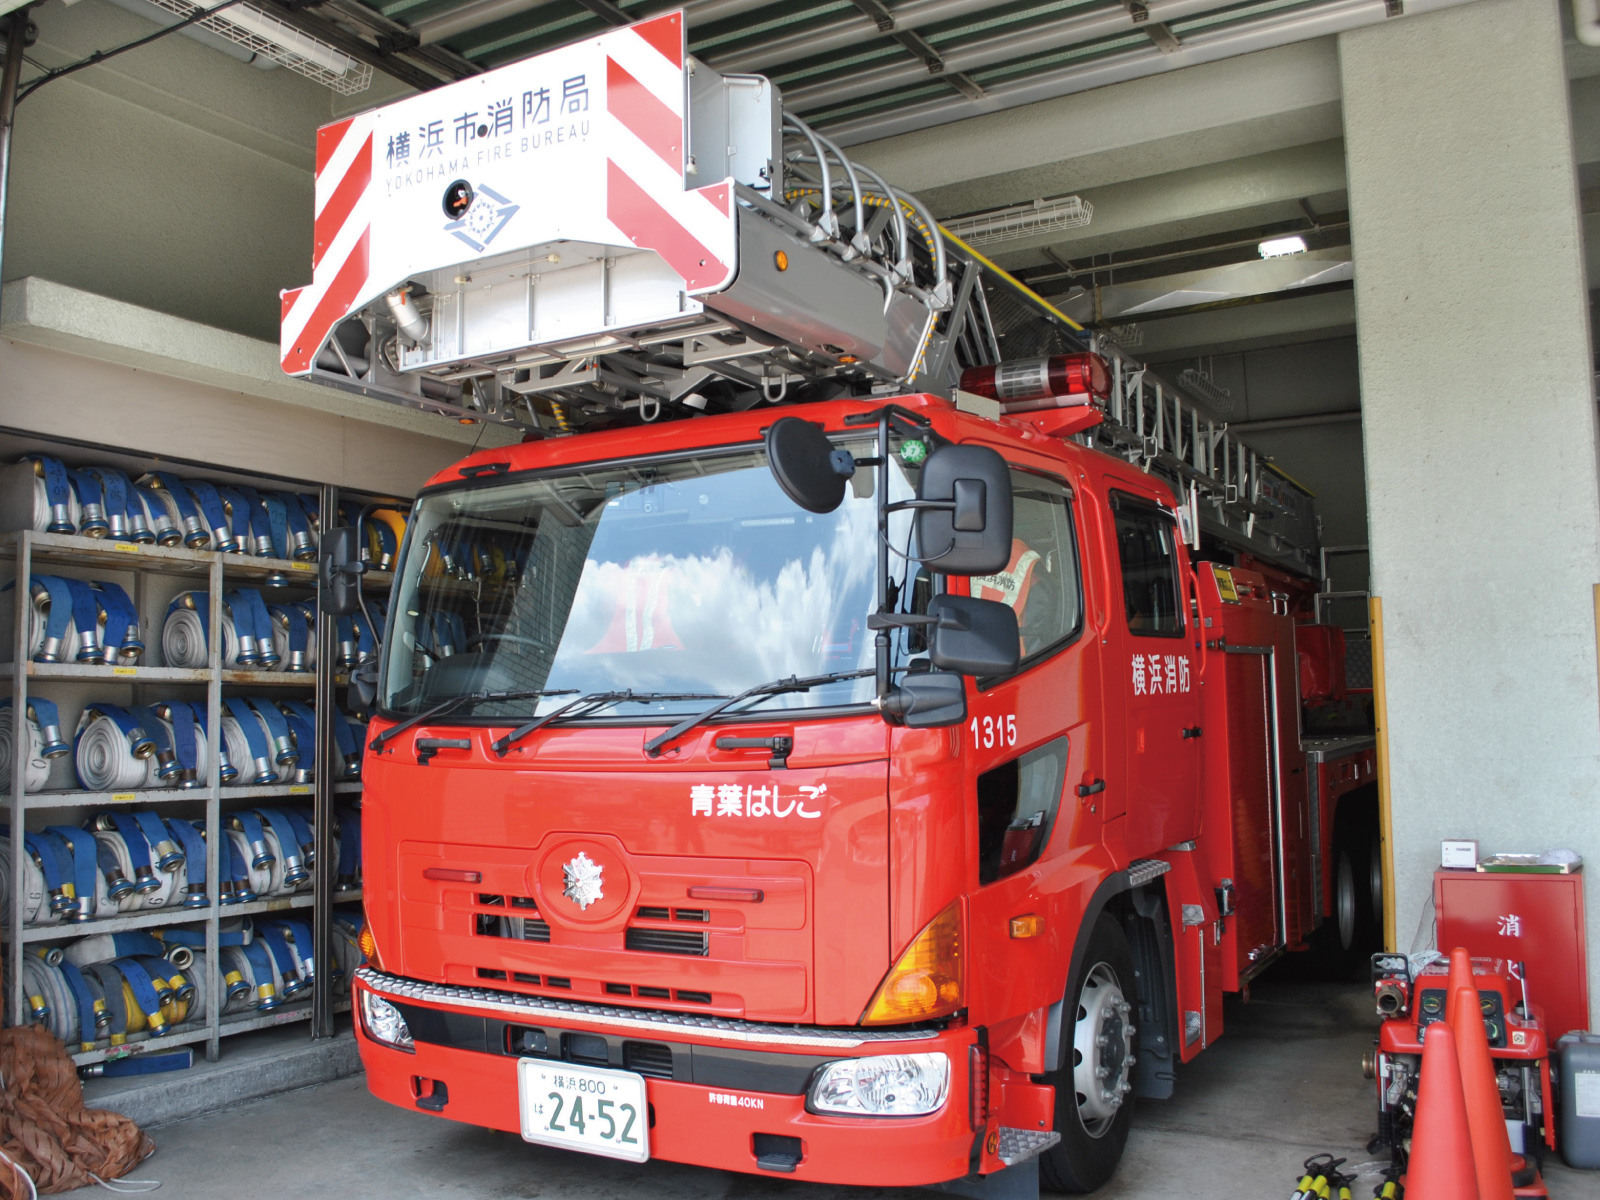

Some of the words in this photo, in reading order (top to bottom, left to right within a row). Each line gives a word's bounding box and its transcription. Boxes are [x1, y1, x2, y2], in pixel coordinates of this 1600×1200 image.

[386, 74, 589, 170] 横浜市消防局
[385, 156, 470, 192] YOKOHAMA
[476, 142, 513, 167] FIRE
[520, 119, 591, 154] BUREAU
[1131, 654, 1191, 696] 横浜消防
[970, 714, 1017, 749] 1315
[690, 783, 828, 819] 青葉はしご
[534, 1103, 544, 1115] は
[548, 1091, 638, 1145] 24-52
